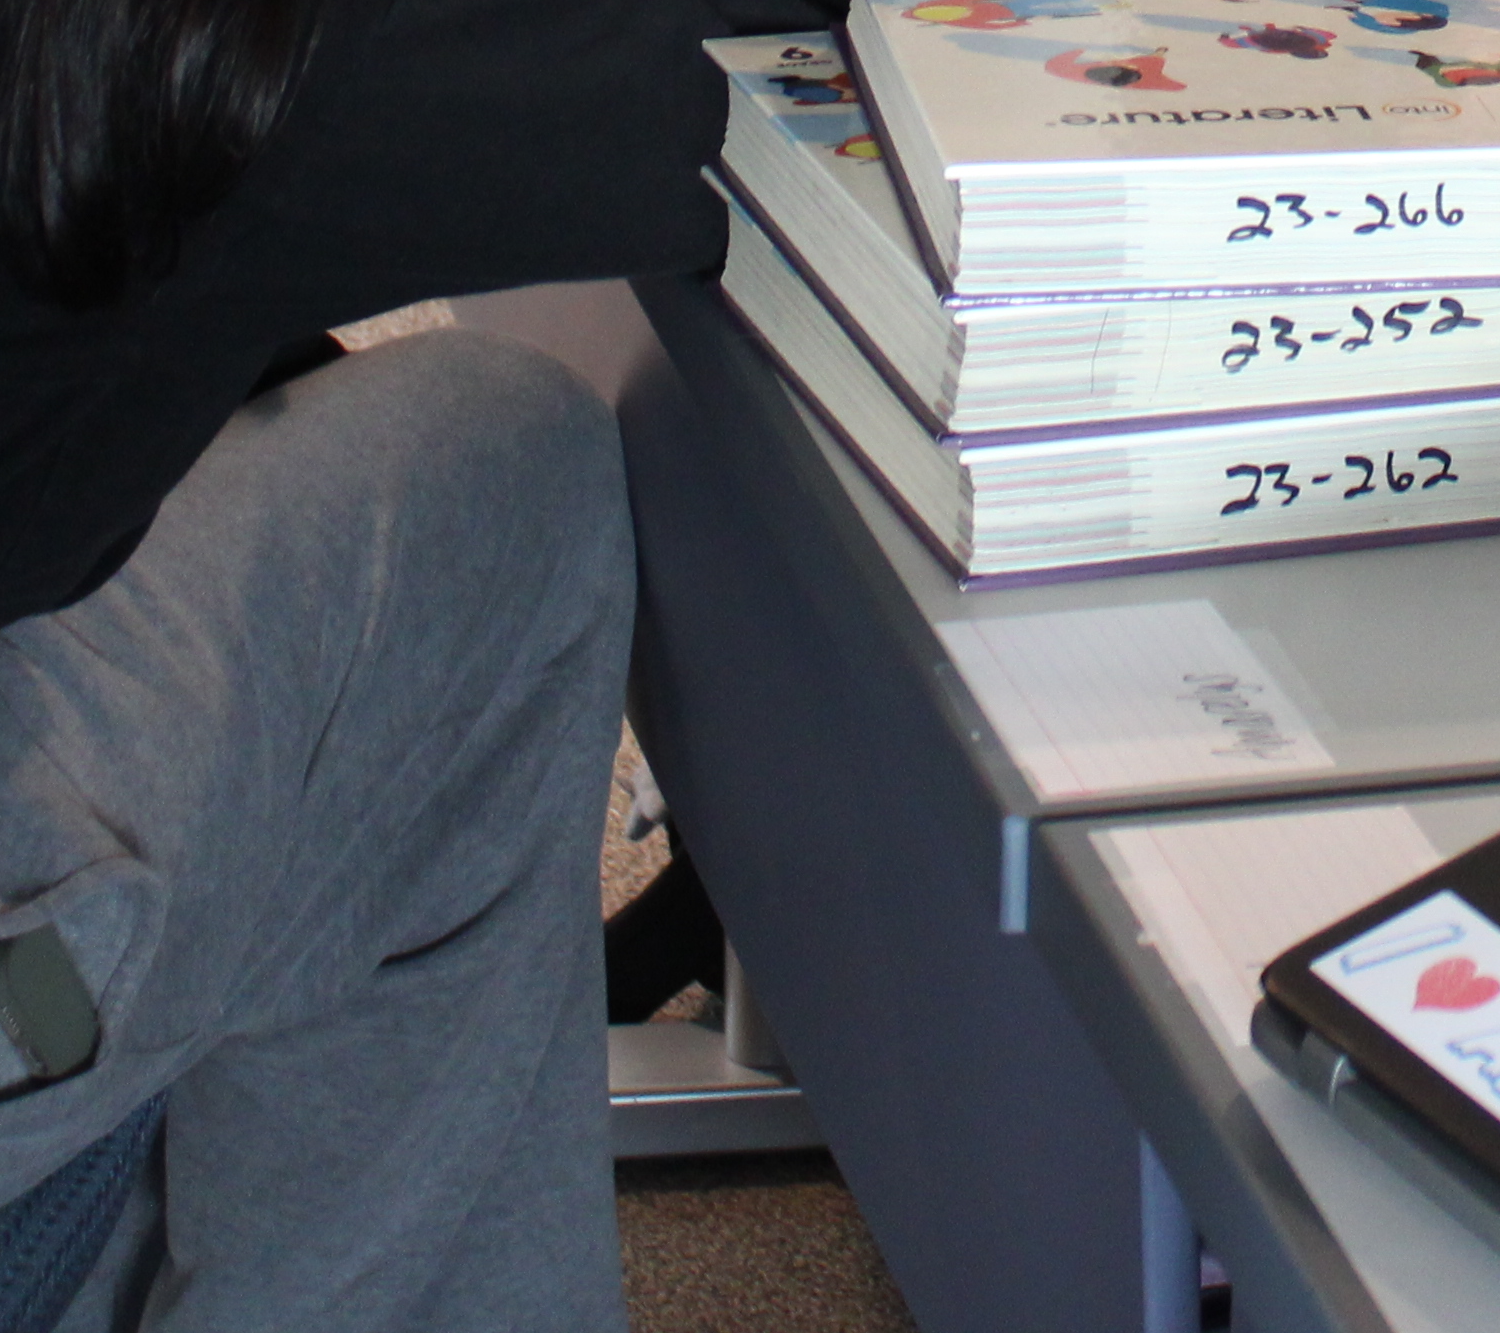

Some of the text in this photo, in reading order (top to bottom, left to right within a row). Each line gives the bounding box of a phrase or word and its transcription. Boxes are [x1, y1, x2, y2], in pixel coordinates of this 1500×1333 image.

[1058, 103, 1371, 127] Literature
[1227, 183, 1464, 242] 23-266
[1222, 297, 1484, 373] 23-252
[1221, 447, 1459, 516] 23-262
[1339, 921, 1467, 975] I
